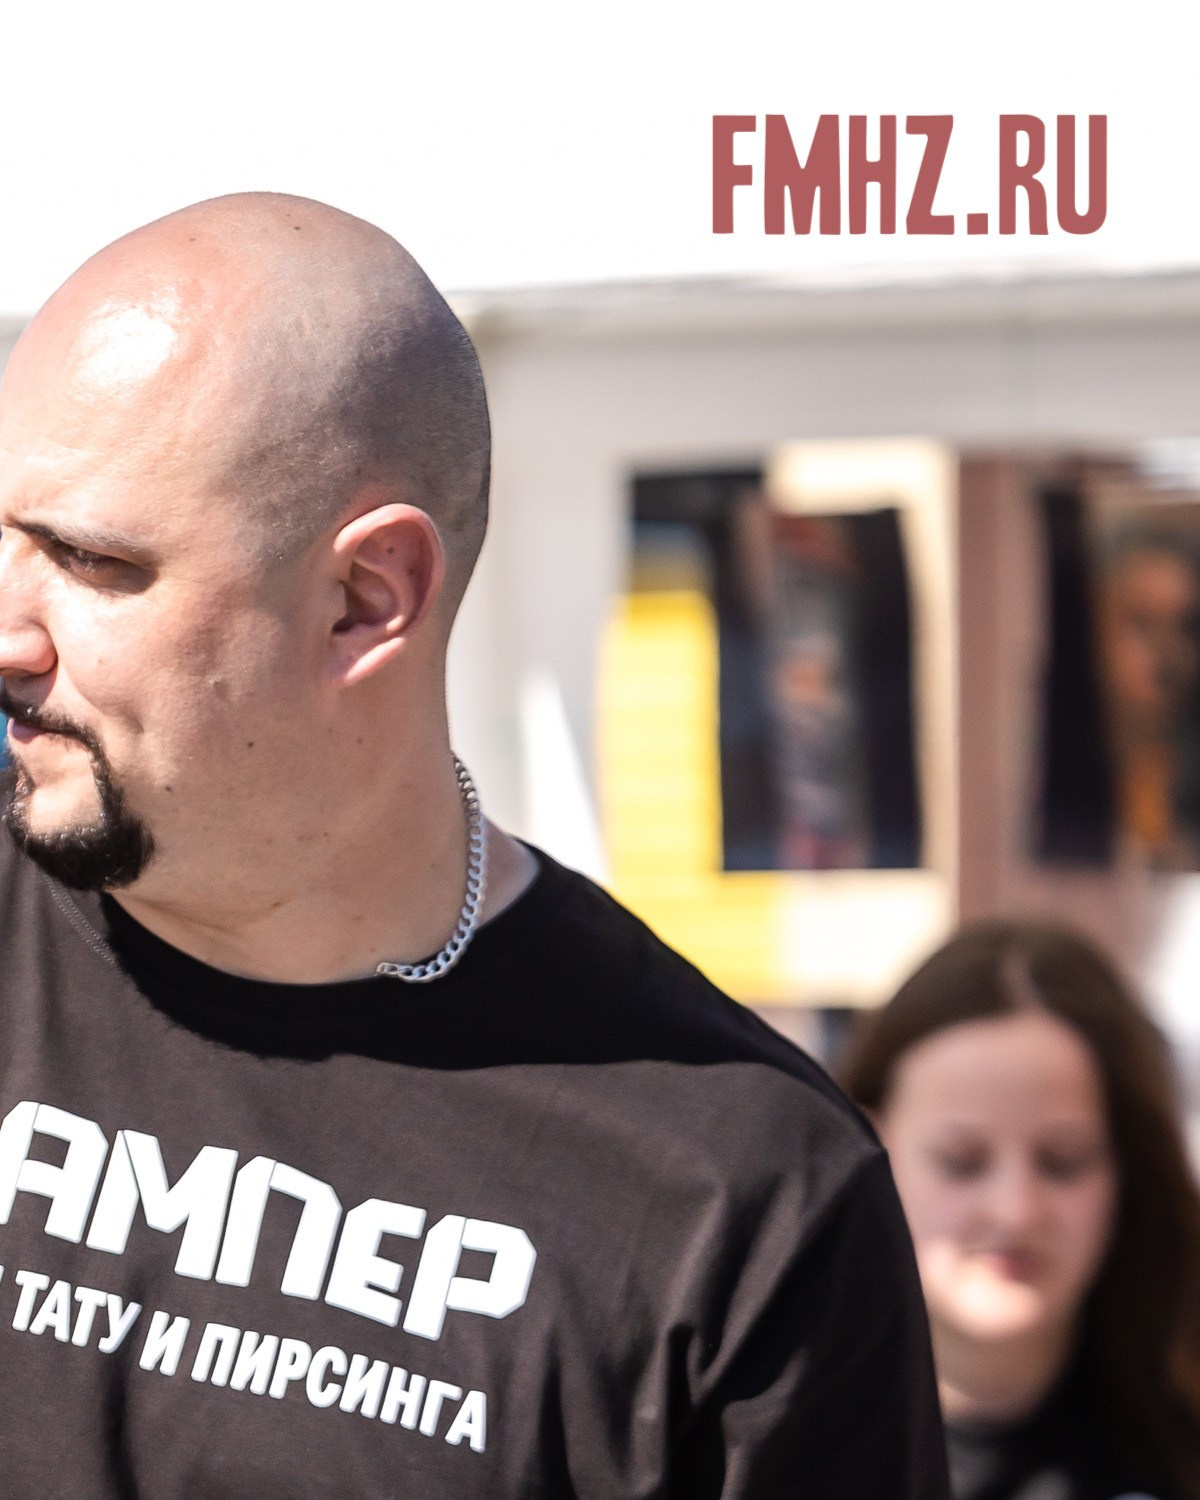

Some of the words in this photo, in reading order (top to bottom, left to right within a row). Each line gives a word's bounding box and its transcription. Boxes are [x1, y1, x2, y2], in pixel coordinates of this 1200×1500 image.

[11, 1269, 142, 1354] ТАТУ
[138, 1310, 191, 1377] И
[190, 1322, 487, 1453] ПИРСИНГА
